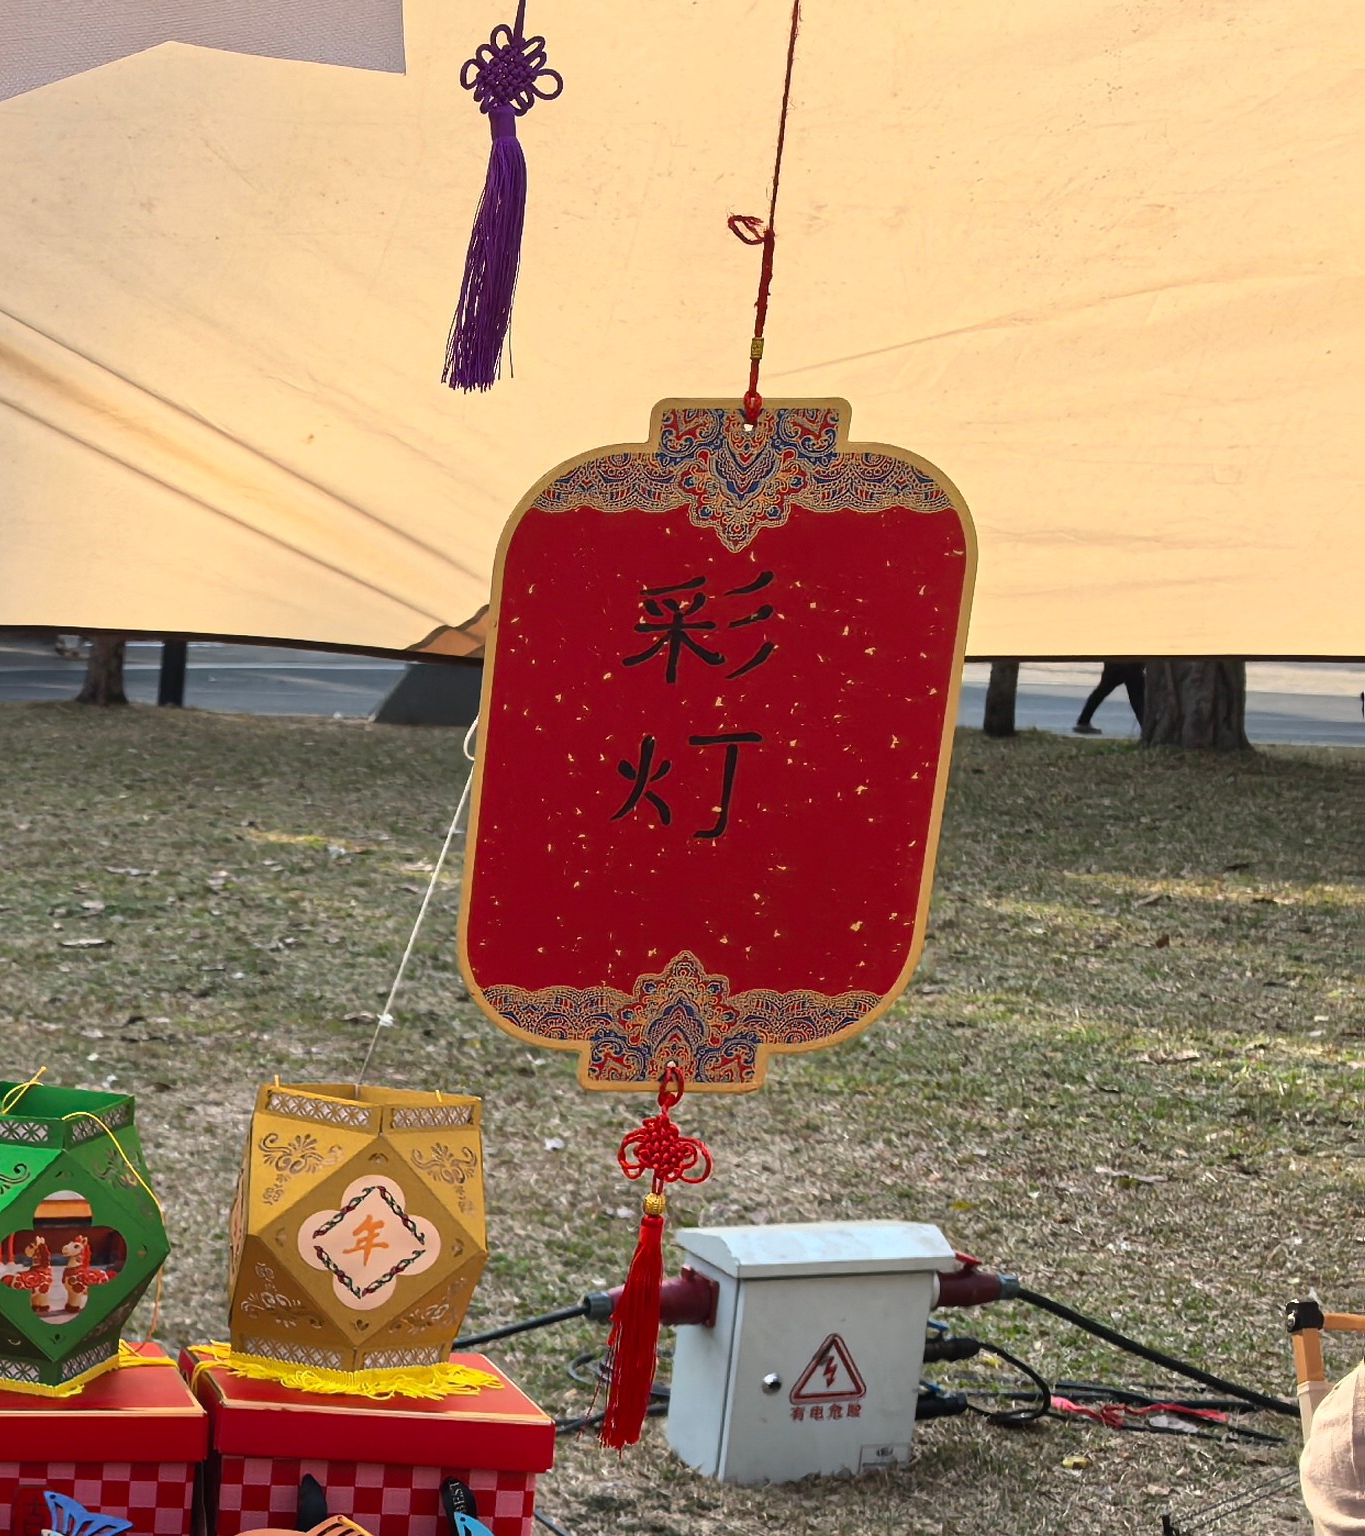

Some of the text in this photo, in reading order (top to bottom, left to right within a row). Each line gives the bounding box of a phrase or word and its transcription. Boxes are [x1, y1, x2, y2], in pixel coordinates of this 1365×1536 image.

[610, 570, 776, 839] 彩灯
[342, 1214, 389, 1267] 年
[790, 1403, 862, 1423] 有电危险
